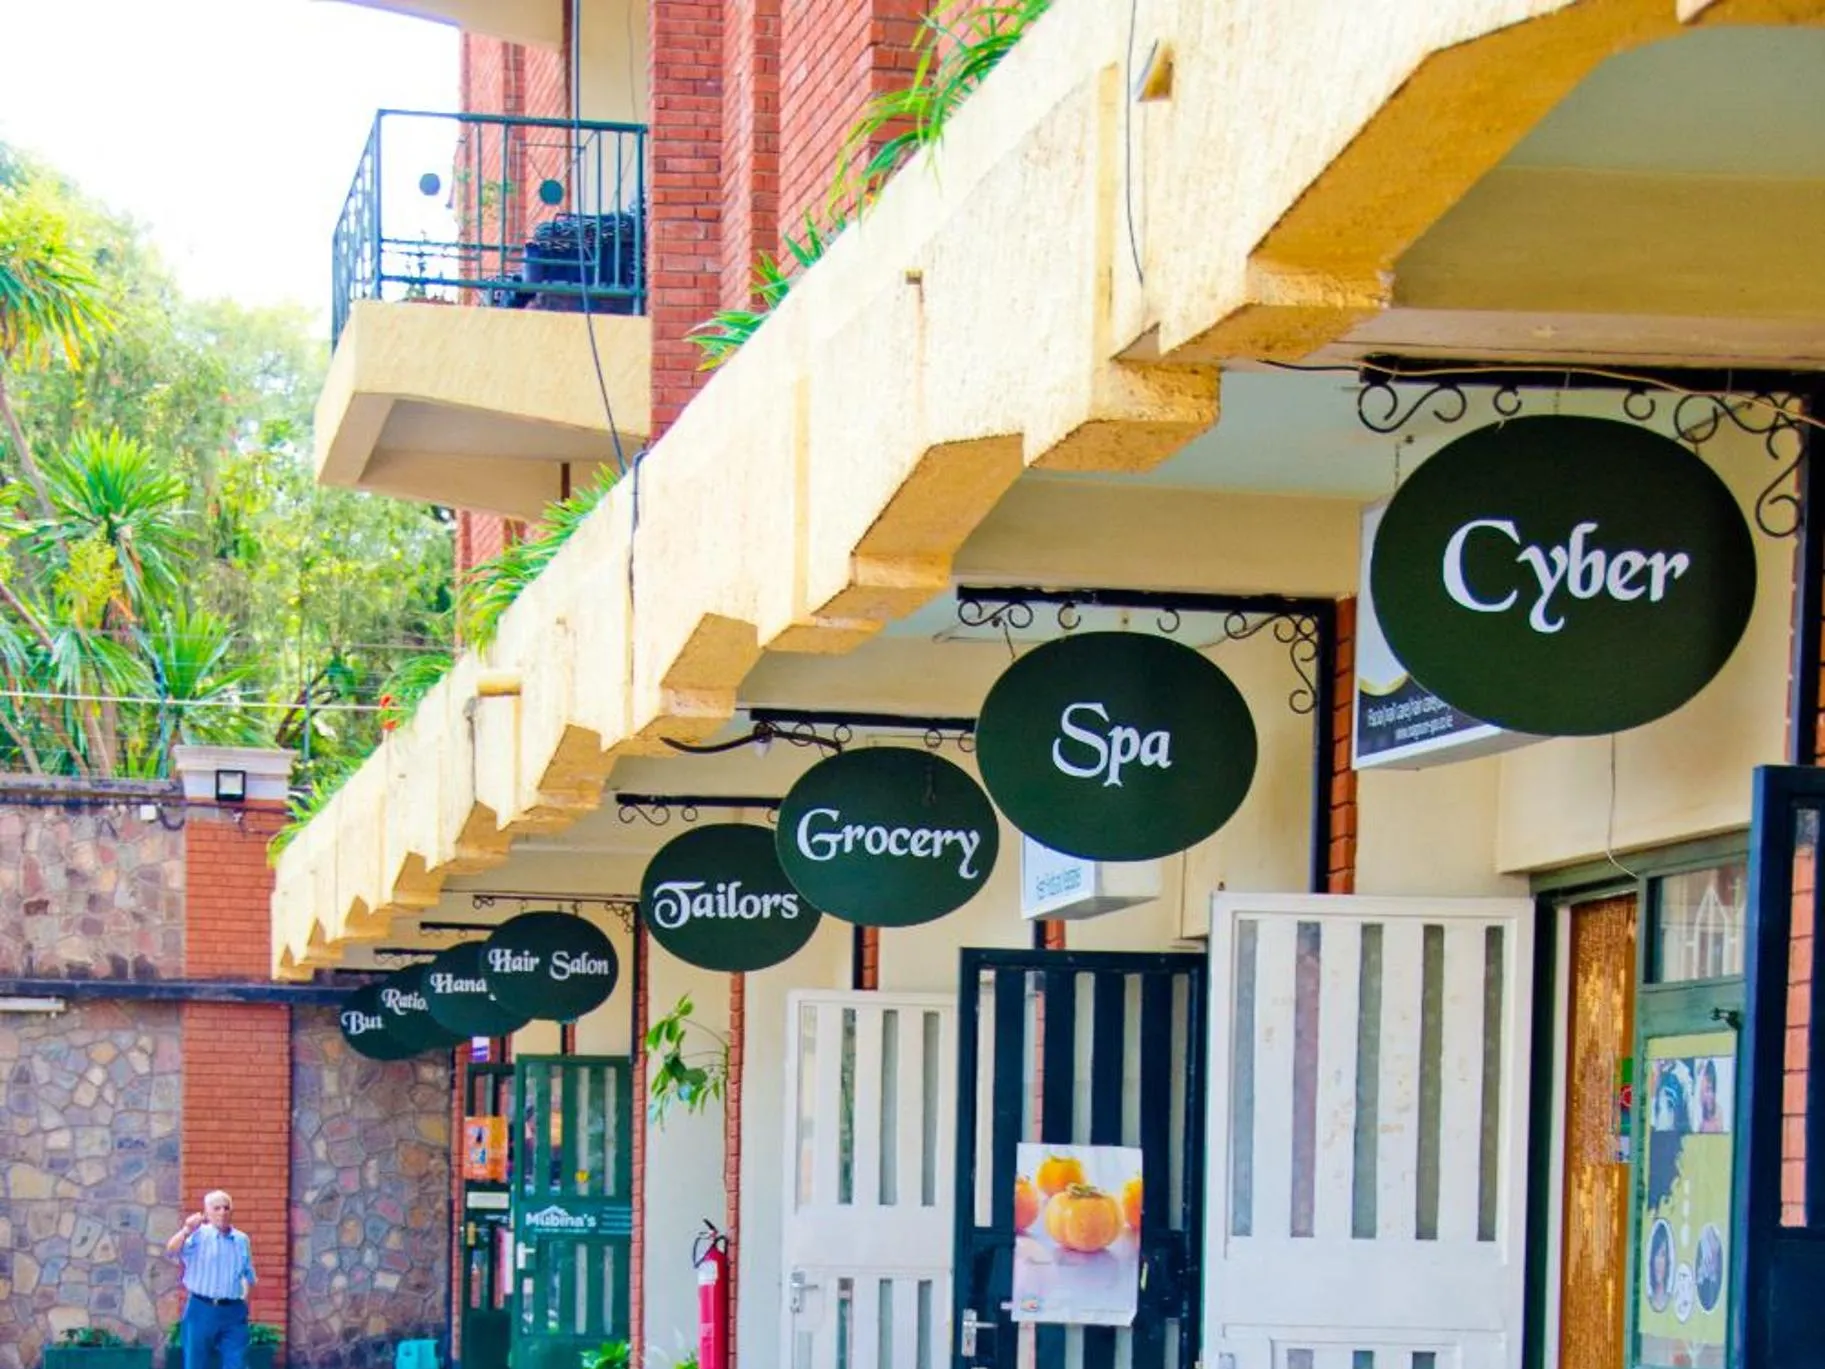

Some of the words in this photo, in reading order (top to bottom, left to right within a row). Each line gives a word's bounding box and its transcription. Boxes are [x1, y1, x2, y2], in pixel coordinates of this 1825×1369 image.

[1443, 520, 1689, 633] Cyber
[1053, 702, 1172, 786] Spa
[797, 807, 980, 878] Grocery
[653, 880, 799, 929] Tailors
[488, 948, 540, 973] Hair
[549, 950, 609, 981] Salon
[381, 988, 429, 1015] Ratio
